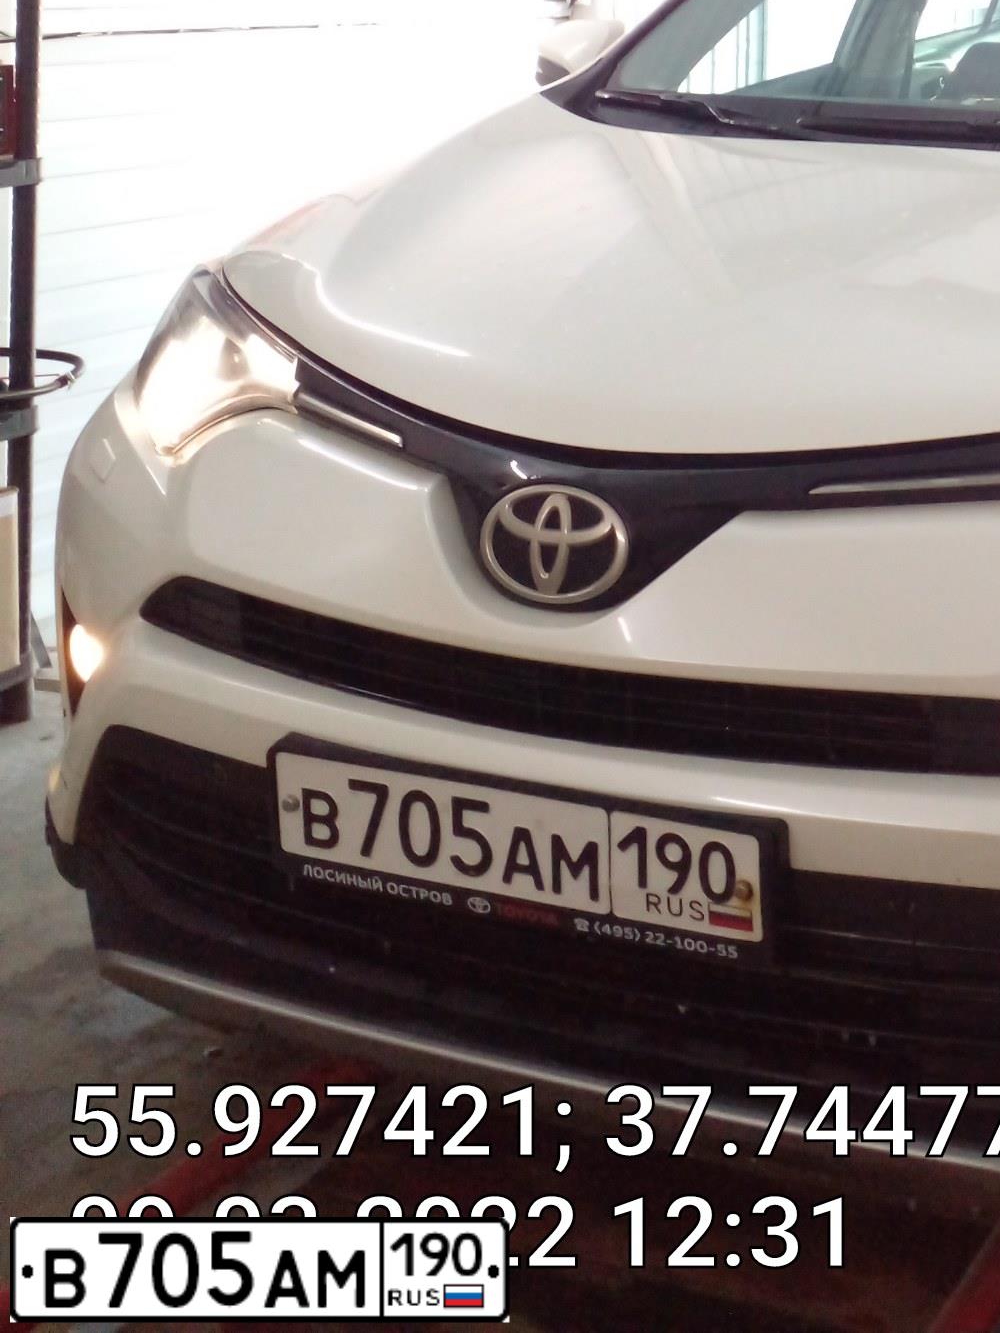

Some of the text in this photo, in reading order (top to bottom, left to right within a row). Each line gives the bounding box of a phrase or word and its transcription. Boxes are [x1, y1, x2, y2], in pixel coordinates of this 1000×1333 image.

[616, 825, 737, 904] 190
[303, 864, 453, 906] ЛОСИНЫЙ ОСТРОВ
[646, 893, 705, 921] RUS
[593, 920, 641, 942] (495)
